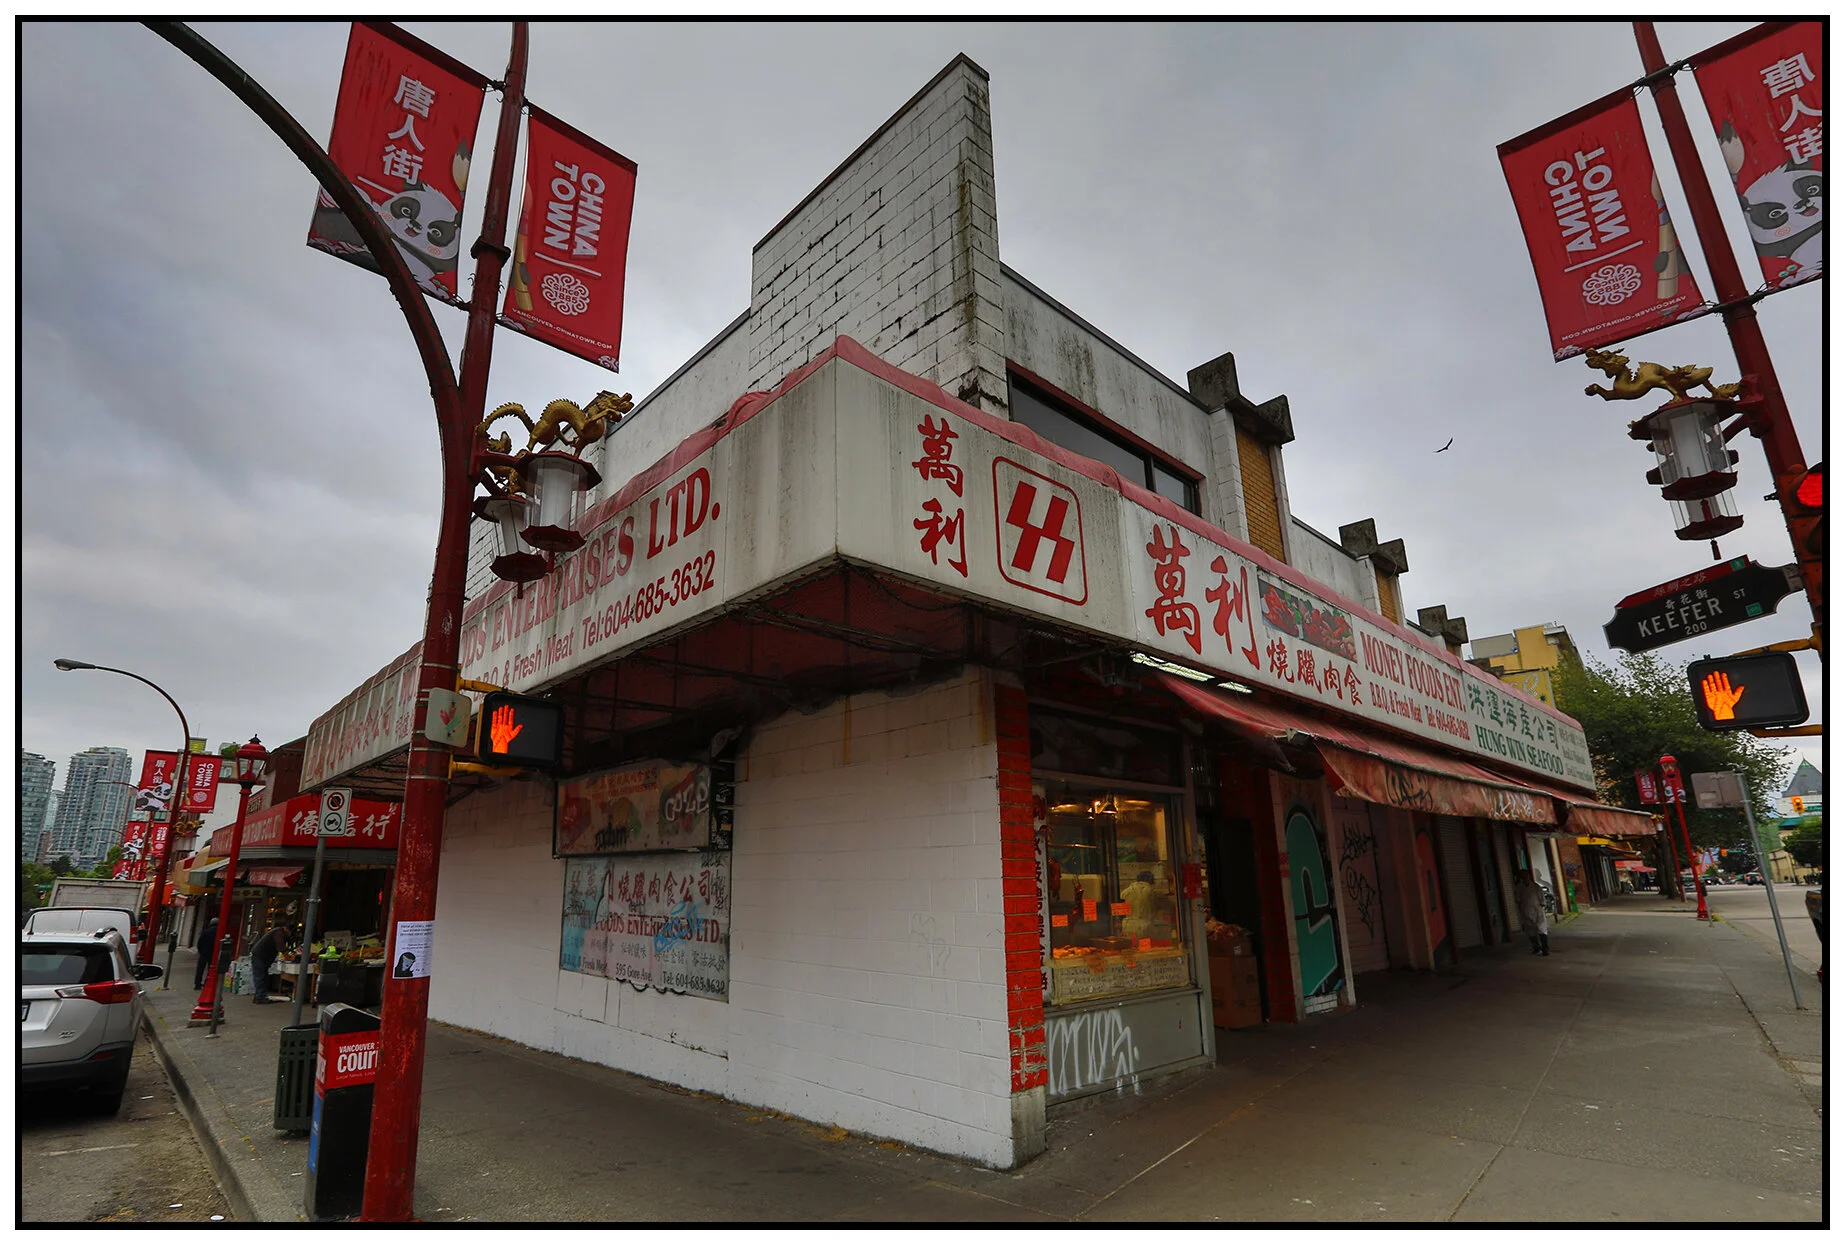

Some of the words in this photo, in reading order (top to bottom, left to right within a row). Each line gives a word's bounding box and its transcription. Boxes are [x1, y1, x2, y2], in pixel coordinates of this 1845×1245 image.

[380, 74, 434, 185] 唐人街
[543, 160, 578, 250] TOWN
[572, 172, 605, 257] CHINA
[552, 283, 579, 297] Since
[553, 290, 578, 304] 1885
[911, 413, 968, 578] 萬利
[491, 516, 635, 653] ENTERPRISES
[646, 467, 721, 561] LTD.
[1144, 523, 1261, 670] 萬利
[1636, 597, 1724, 639] KEEFER
[1732, 587, 1747, 600] ST
[1685, 621, 1708, 636] 200
[502, 660, 510, 688] &
[512, 642, 543, 684] Fresh
[544, 625, 575, 668] Meat
[1360, 631, 1406, 686] MONEY
[1405, 653, 1445, 703] FOODS
[1443, 672, 1467, 713] ENT.
[1394, 691, 1411, 719] Fresh
[194, 762, 207, 787] TOWN
[201, 762, 215, 788] CHINA
[1475, 724, 1507, 756] HUNG
[1506, 736, 1528, 762] WIN
[1526, 744, 1564, 775] SEAFOOD
[339, 1042, 375, 1053] VANCOUVER
